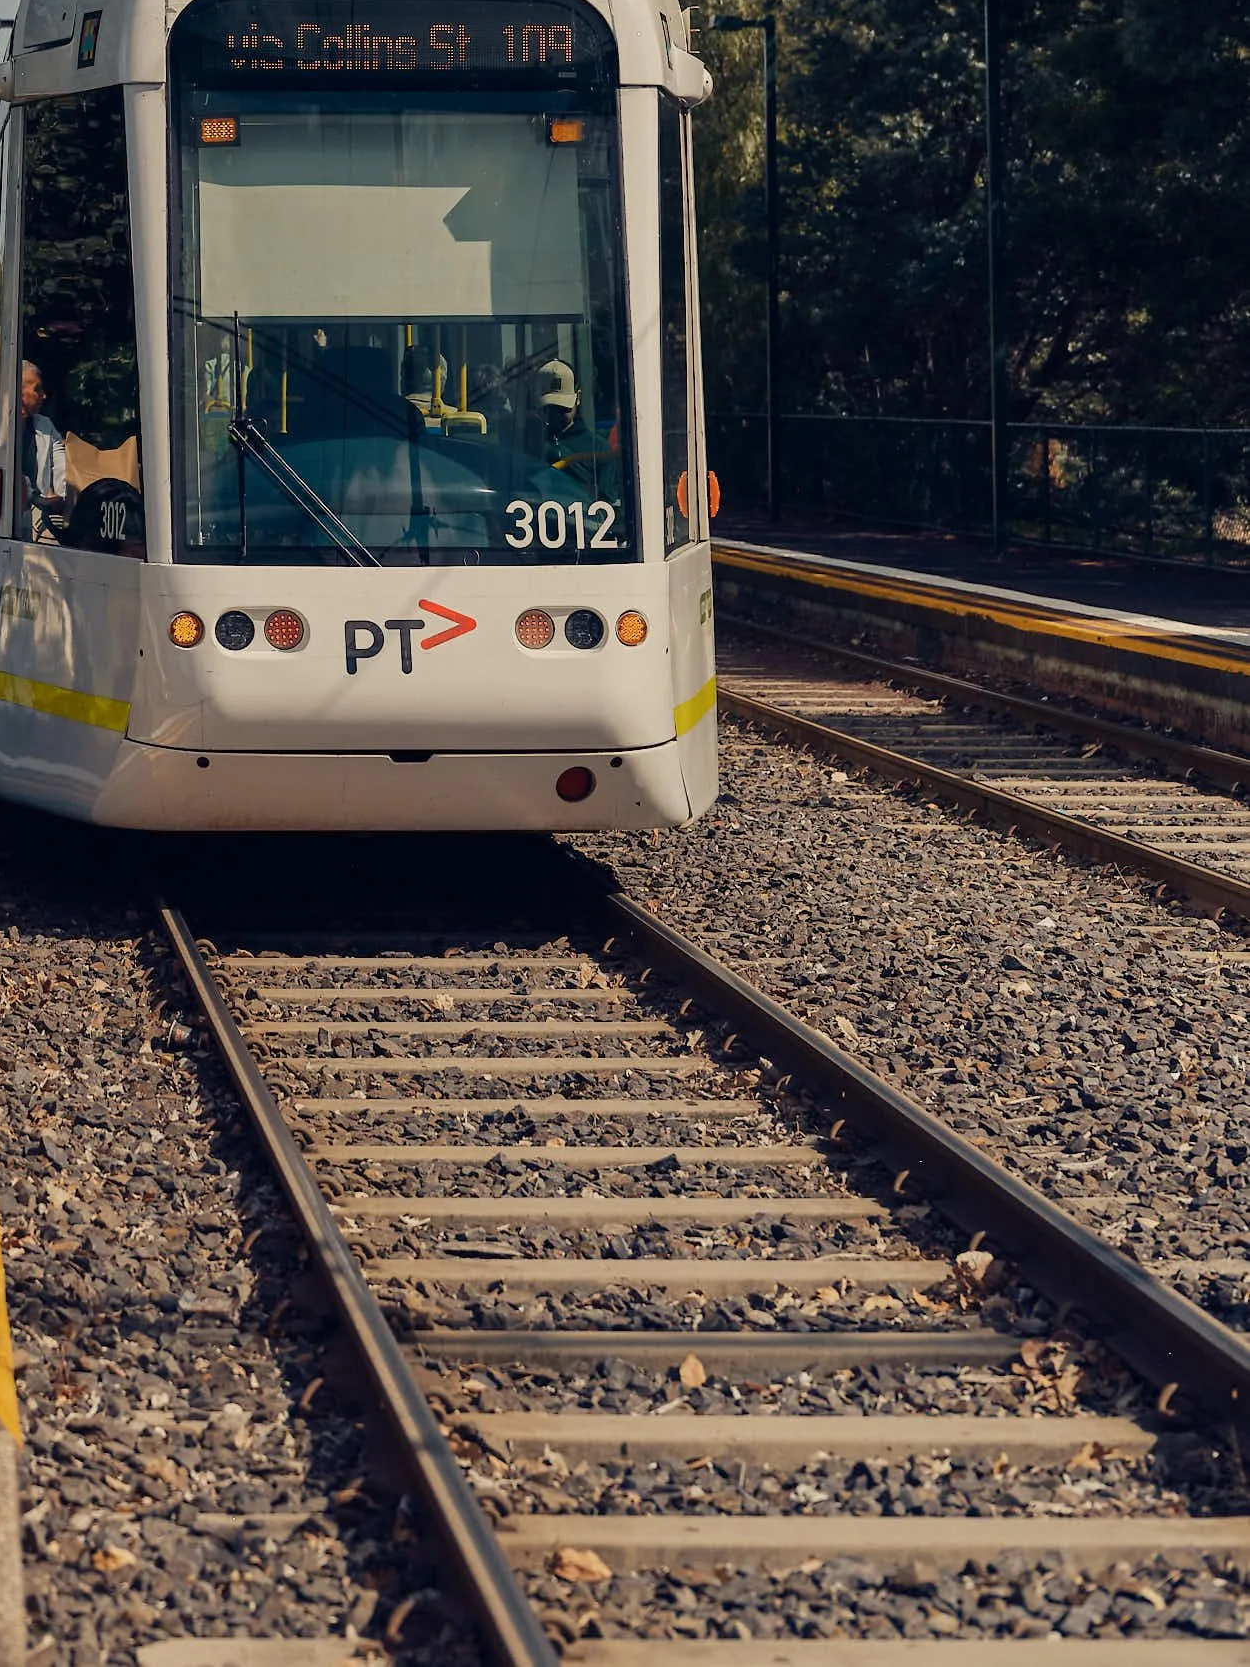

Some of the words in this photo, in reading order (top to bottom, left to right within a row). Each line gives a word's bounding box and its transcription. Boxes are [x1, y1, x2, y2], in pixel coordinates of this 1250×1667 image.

[297, 23, 417, 70] Collins
[430, 24, 471, 70] St
[502, 25, 572, 62] 109
[100, 501, 127, 541] 3012
[505, 500, 619, 550] 3012
